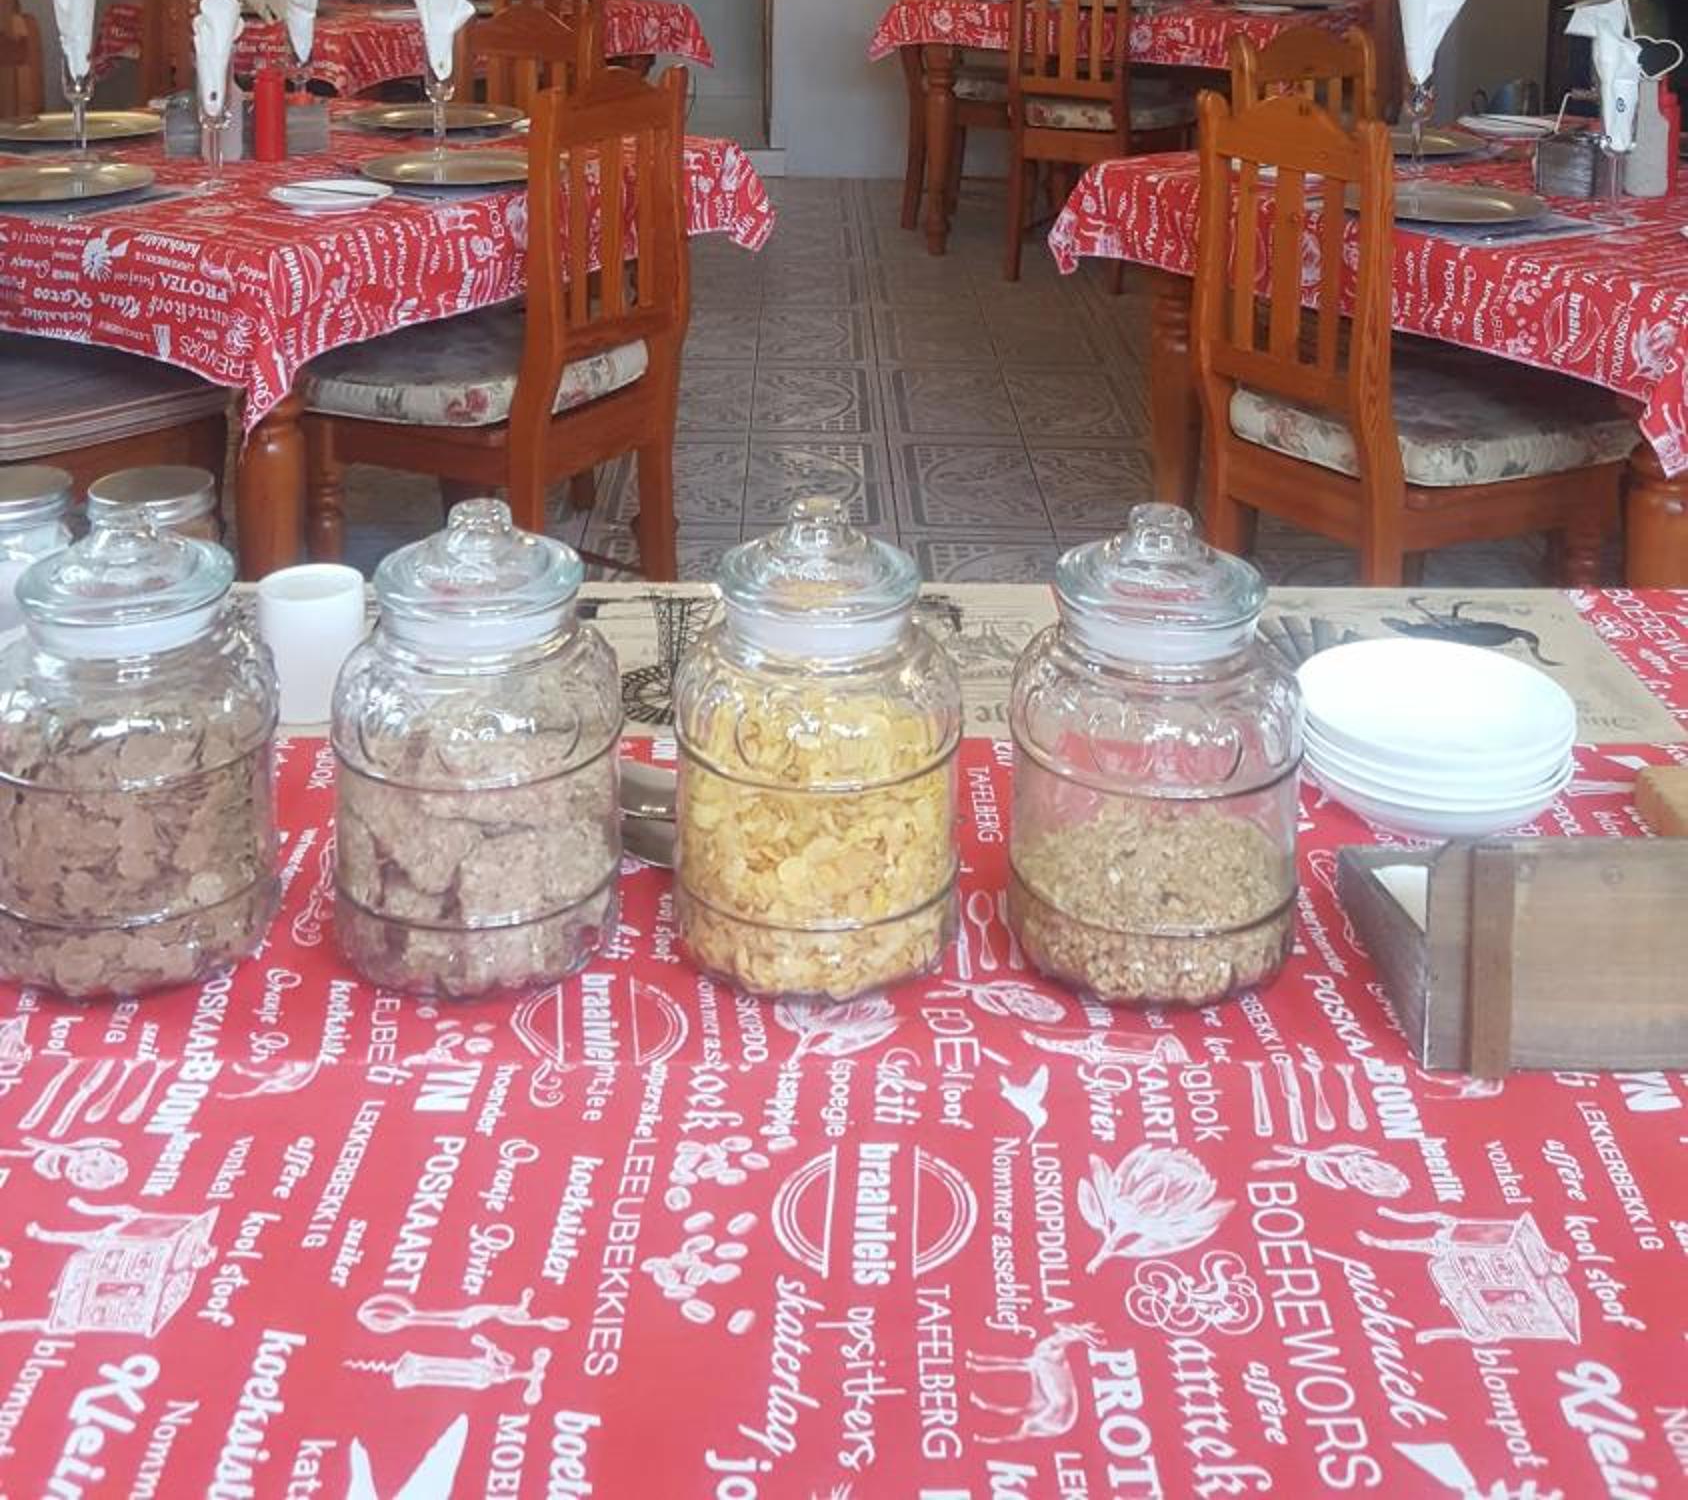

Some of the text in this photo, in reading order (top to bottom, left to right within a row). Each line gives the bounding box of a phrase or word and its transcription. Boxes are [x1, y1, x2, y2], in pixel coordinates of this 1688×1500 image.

[158, 272, 229, 304] PROTEA
[965, 765, 1004, 844] TAFELBERG
[40, 1015, 85, 1058] kool
[252, 967, 302, 1025] Oranje
[143, 1059, 224, 1134] BOON
[1077, 1063, 1133, 1142] Rivier
[1363, 1063, 1426, 1140] BOON
[207, 1135, 254, 1200] vonkel
[301, 1099, 385, 1250] LEKKERBEKKIG
[382, 1134, 466, 1294] POSKAART
[461, 1138, 539, 1297] Oranje Rivier
[540, 1154, 604, 1286] koeksister
[851, 1142, 899, 1287] braaivleis
[1030, 1141, 1075, 1315] LOSKOPDOLLA
[1483, 1139, 1532, 1205] vonkel
[1575, 1100, 1665, 1251] LEKKERBEKKIG
[197, 1210, 281, 1328] kool stoof
[329, 1218, 369, 1288] suiker
[584, 1137, 654, 1377] LEEUBEKKIES
[984, 1136, 1037, 1340] Nommer asseblief
[1562, 1213, 1648, 1332] kool stoof
[815, 1305, 906, 1473] opsitkers
[915, 1283, 964, 1460] TAFELBERG
[1246, 1181, 1383, 1490] BOEREWORS
[1311, 1247, 1449, 1429] piekniek
[1087, 1346, 1165, 1500] PROT
[1470, 1347, 1551, 1470] blompot
